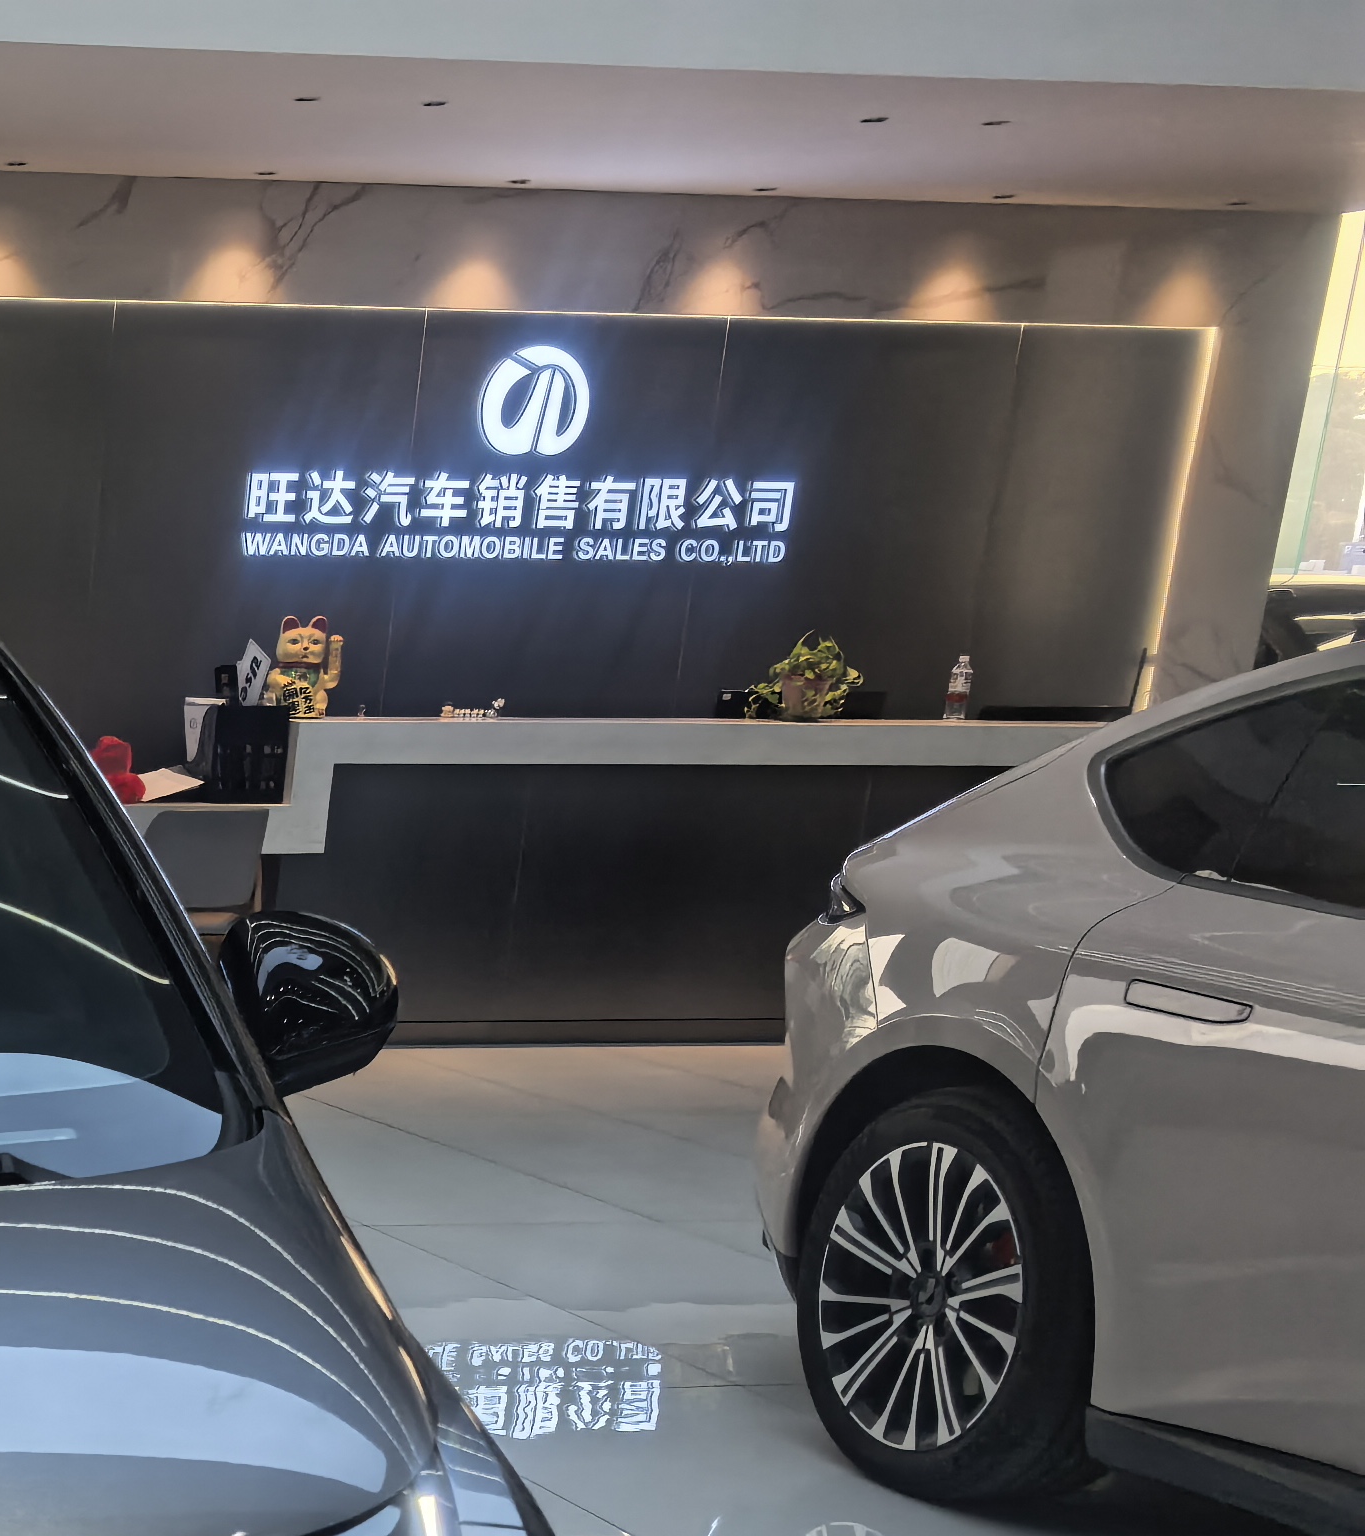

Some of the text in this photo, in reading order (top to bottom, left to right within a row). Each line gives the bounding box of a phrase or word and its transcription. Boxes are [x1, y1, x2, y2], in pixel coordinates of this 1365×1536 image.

[245, 470, 795, 532] 旺达汽车销售有限公司
[242, 532, 785, 566] WANGDA AUTOMOBILE SALES CO.,LTD
